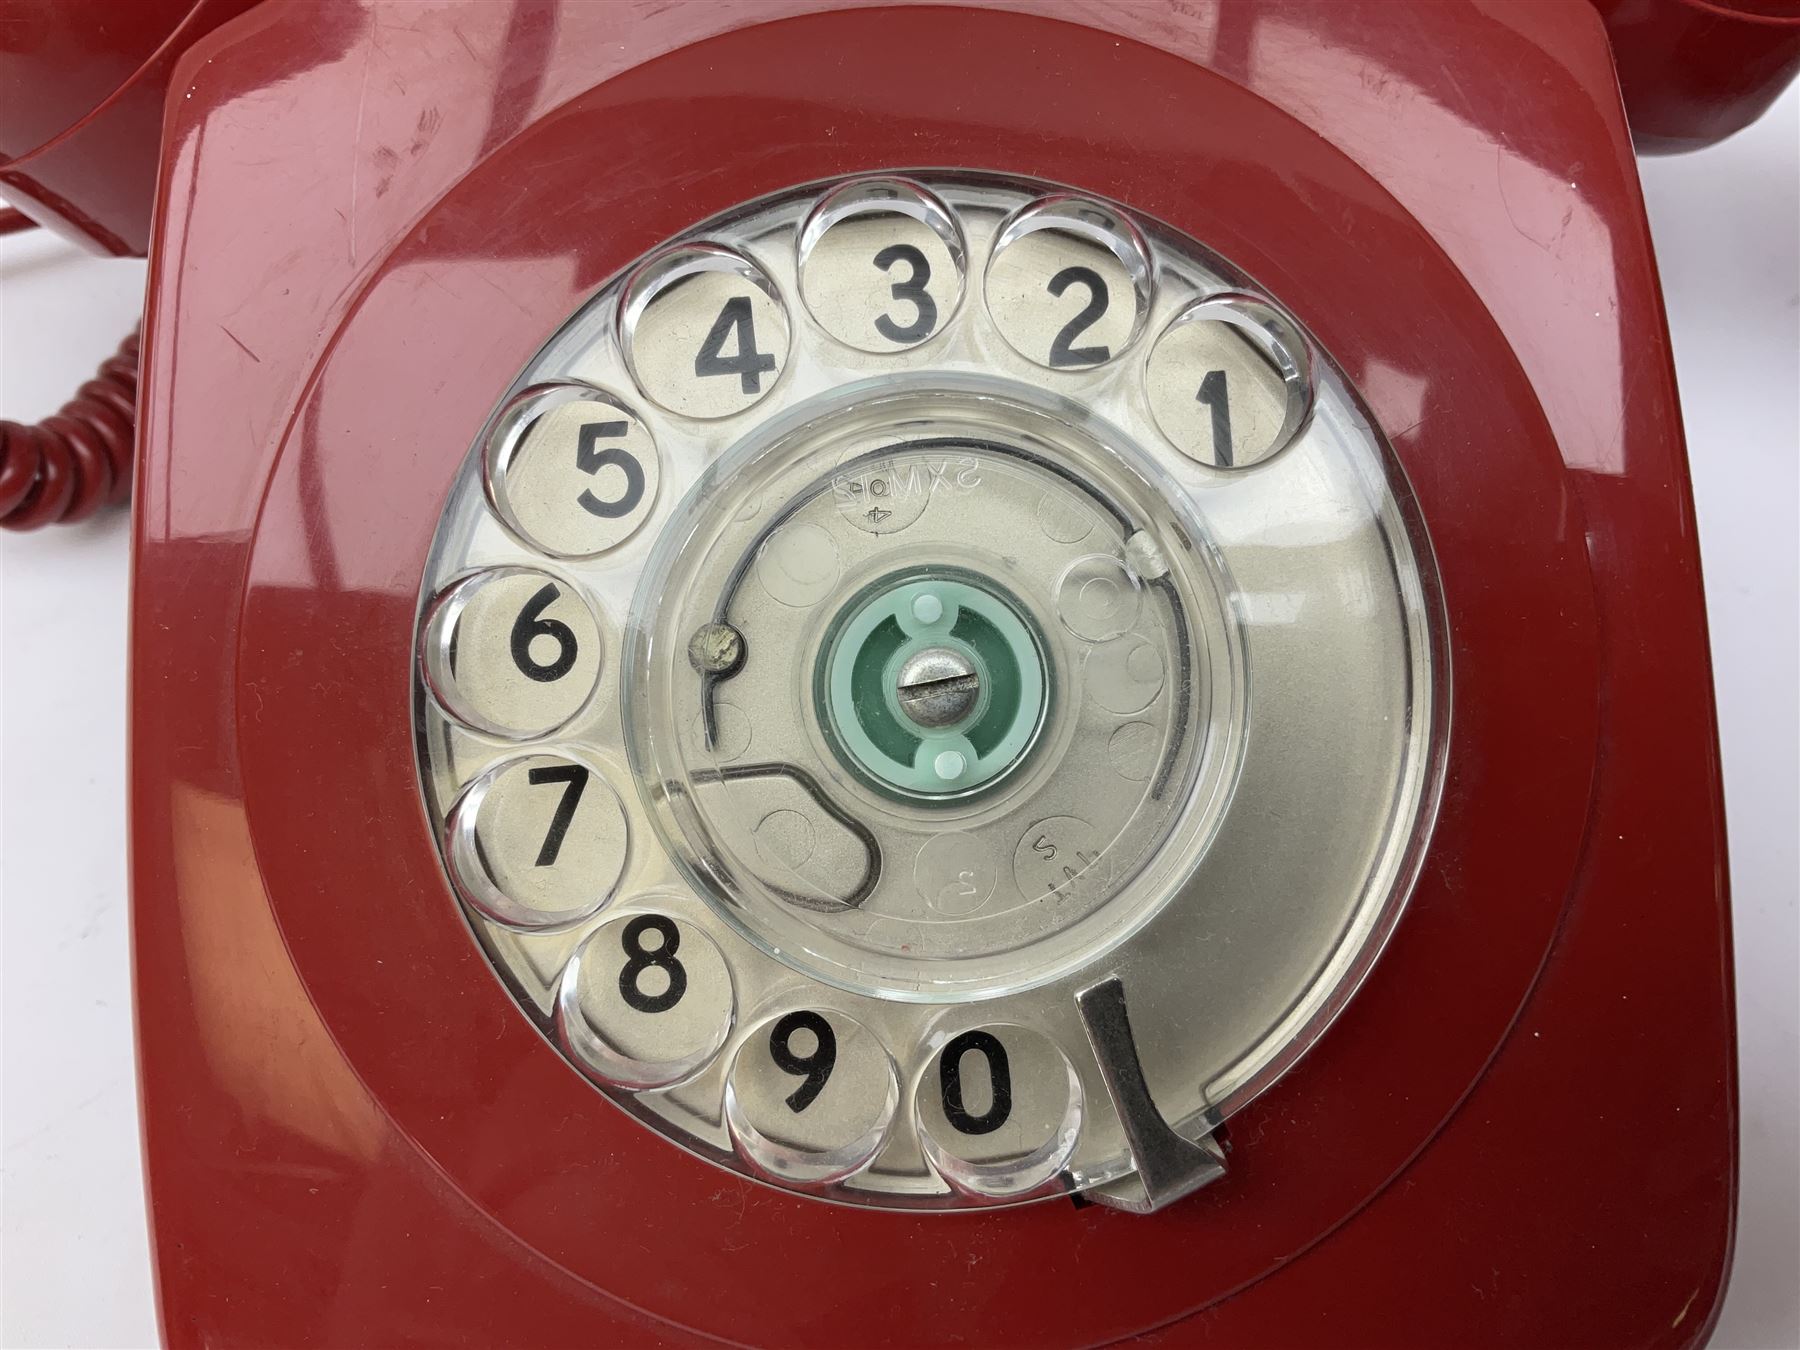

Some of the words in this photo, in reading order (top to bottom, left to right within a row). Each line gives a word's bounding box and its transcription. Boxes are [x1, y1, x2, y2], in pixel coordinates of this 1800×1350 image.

[873, 244, 936, 344] 3
[1046, 266, 1111, 366] 2
[695, 296, 775, 394] 4
[1195, 370, 1233, 467] 1
[577, 421, 645, 518] 5
[511, 582, 577, 682] 6
[529, 764, 589, 866] 7
[619, 914, 687, 1013] 8
[770, 1011, 836, 1113] 9
[940, 1031, 1011, 1135] 0
